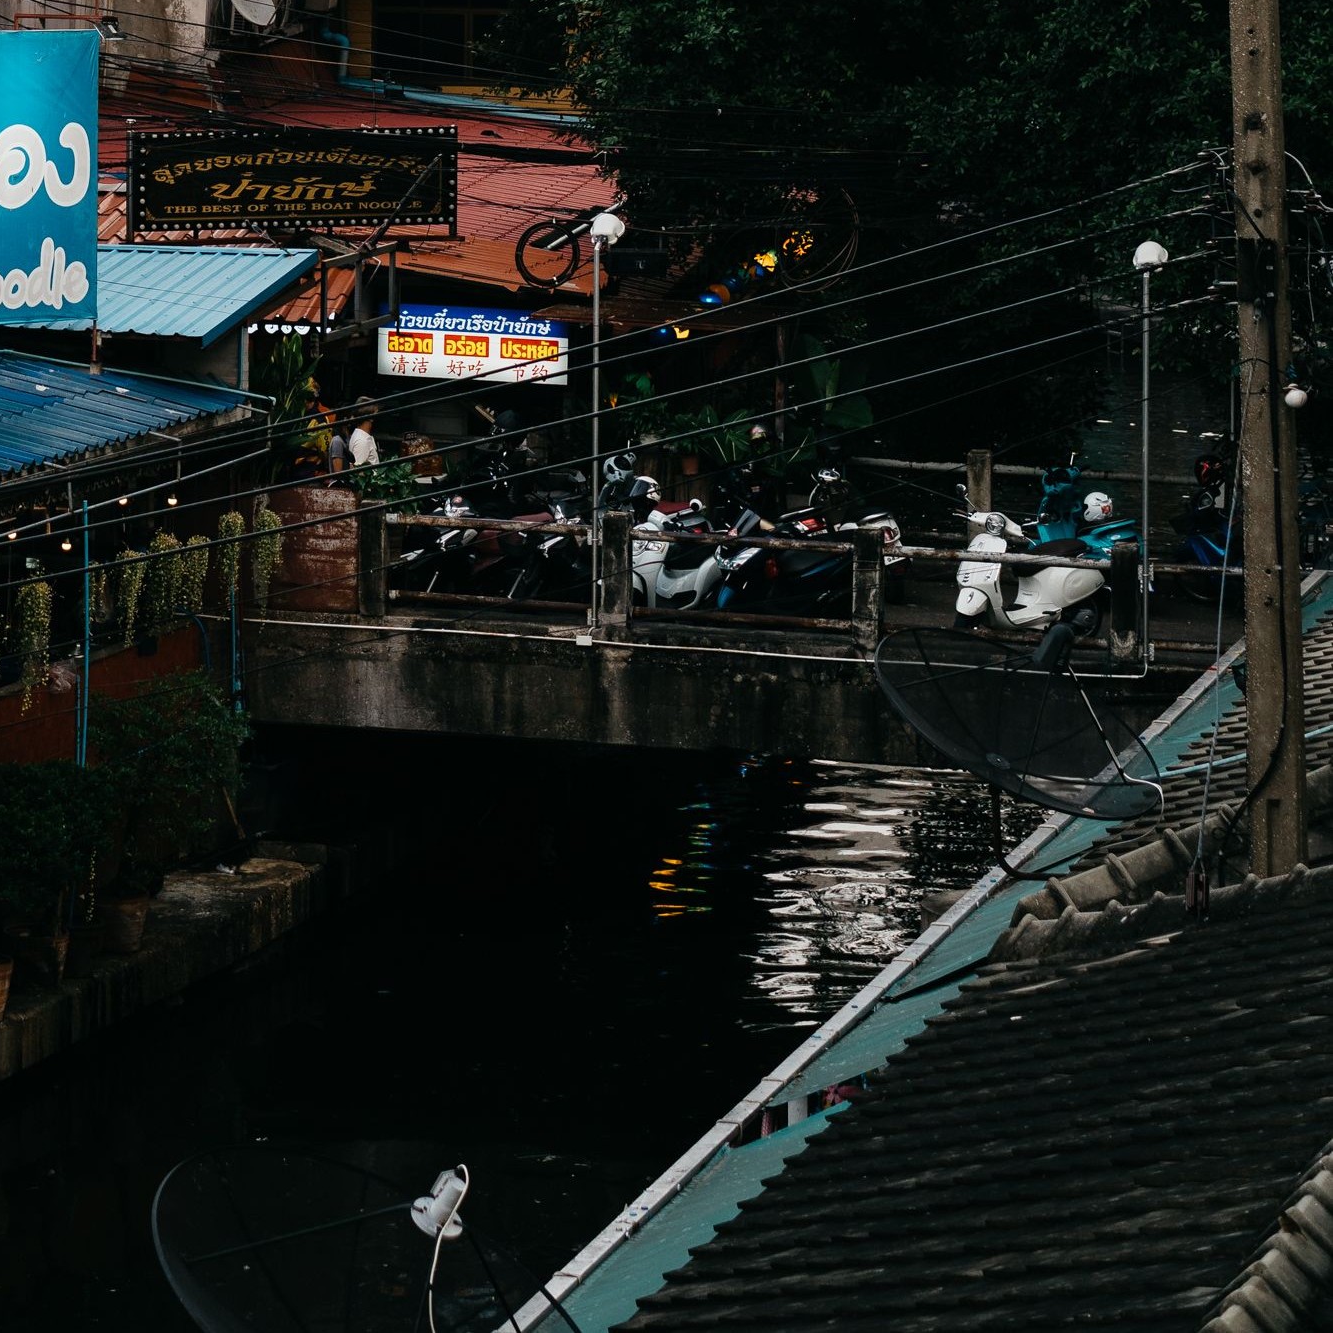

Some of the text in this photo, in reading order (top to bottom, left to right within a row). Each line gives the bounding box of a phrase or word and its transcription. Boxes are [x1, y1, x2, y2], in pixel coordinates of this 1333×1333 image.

[164, 200, 423, 215] THE BEST OF THE BOAT NOODE
[388, 335, 434, 354] สะอาด
[445, 335, 488, 357] อร่อย
[391, 354, 430, 375] 清洁
[447, 359, 484, 377] 好吃
